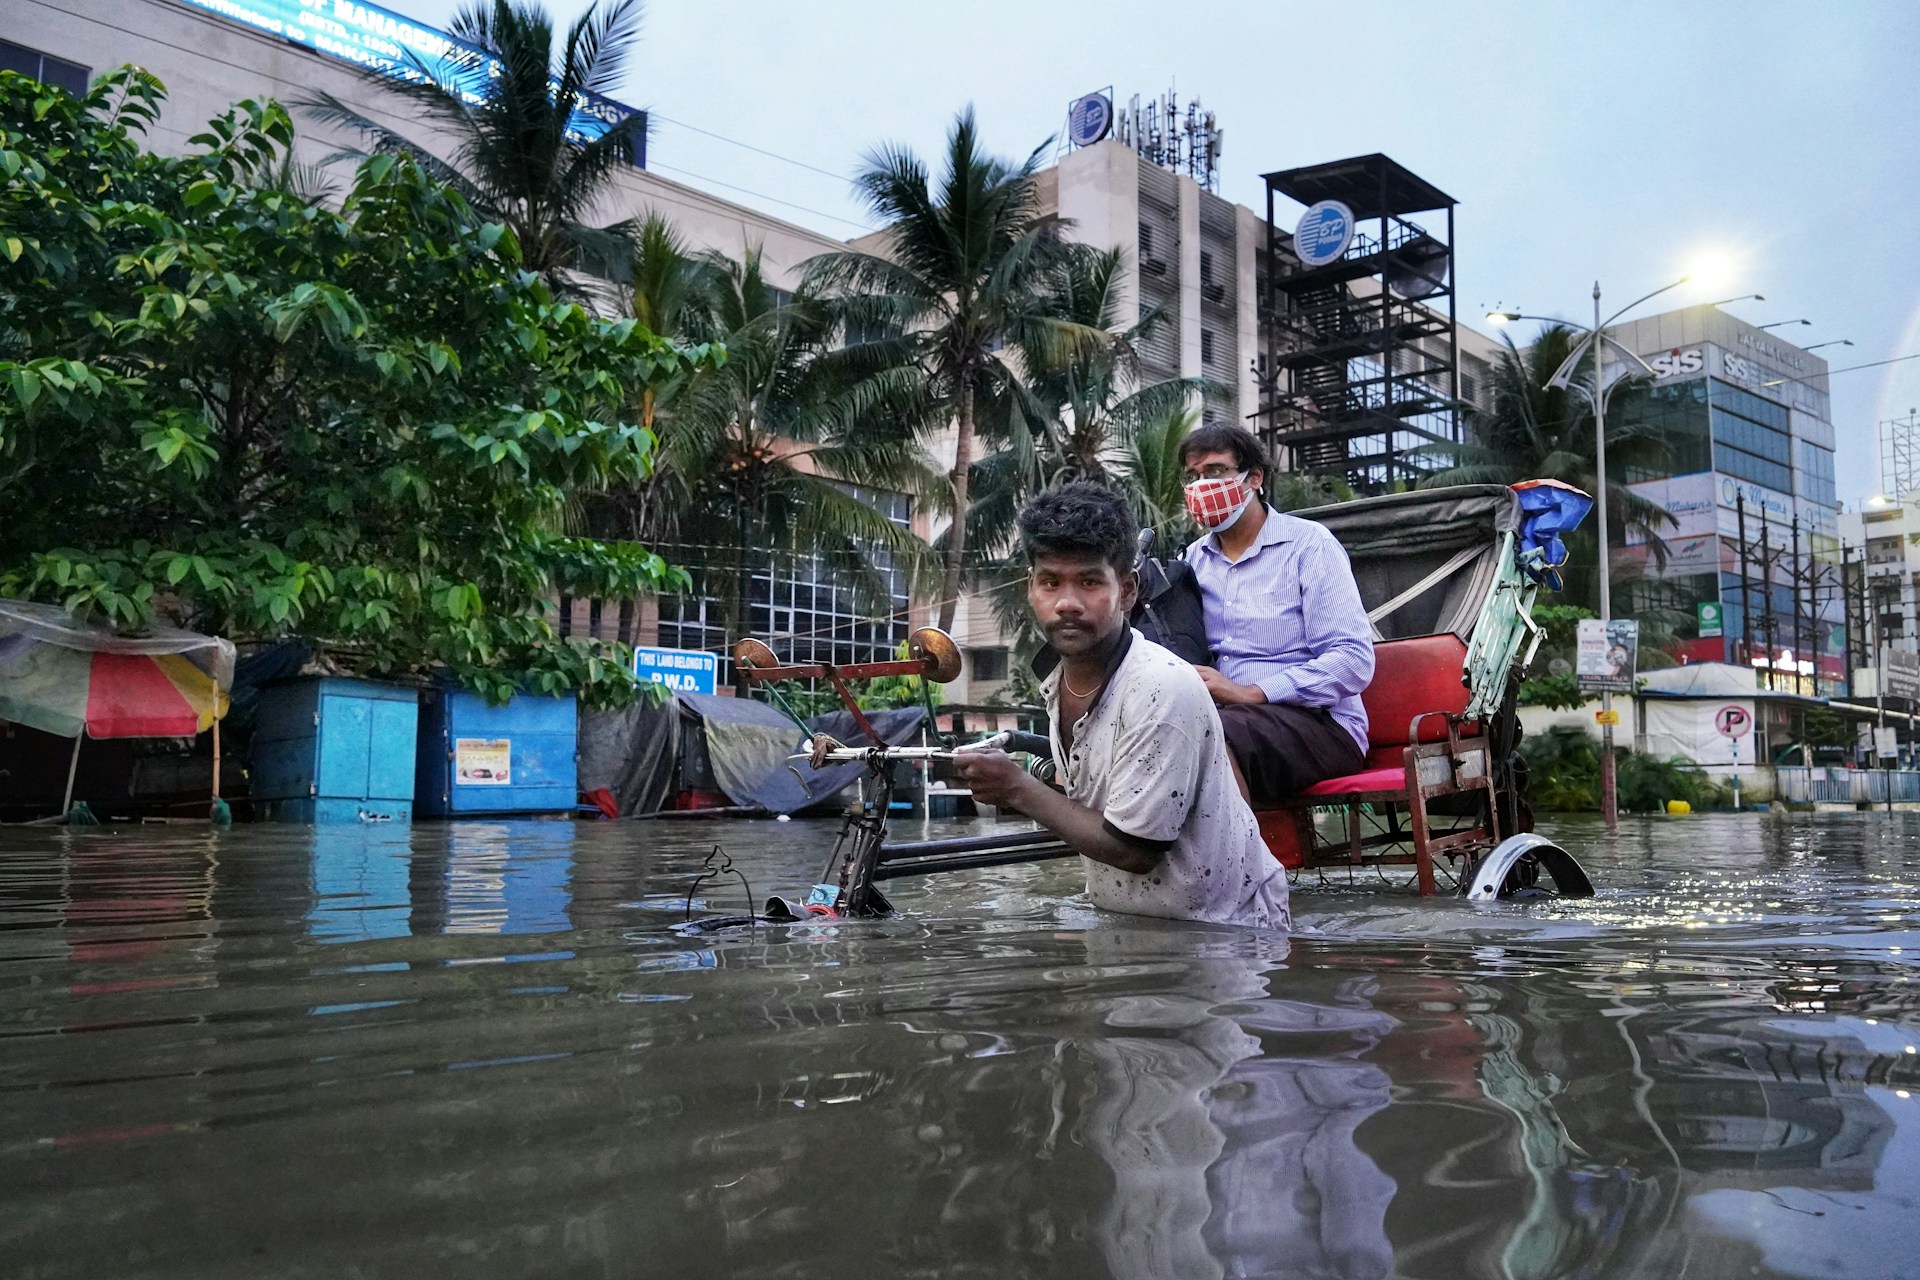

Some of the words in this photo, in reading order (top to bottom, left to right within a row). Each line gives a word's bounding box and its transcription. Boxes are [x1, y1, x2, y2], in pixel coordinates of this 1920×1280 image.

[286, 24, 305, 41] to
[1319, 218, 1344, 237] BP
[640, 652, 656, 667] THIS
[657, 654, 674, 668] LAND
[674, 656, 703, 670] BELONGS
[704, 658, 713, 671] TO
[651, 672, 700, 691] PW.D.
